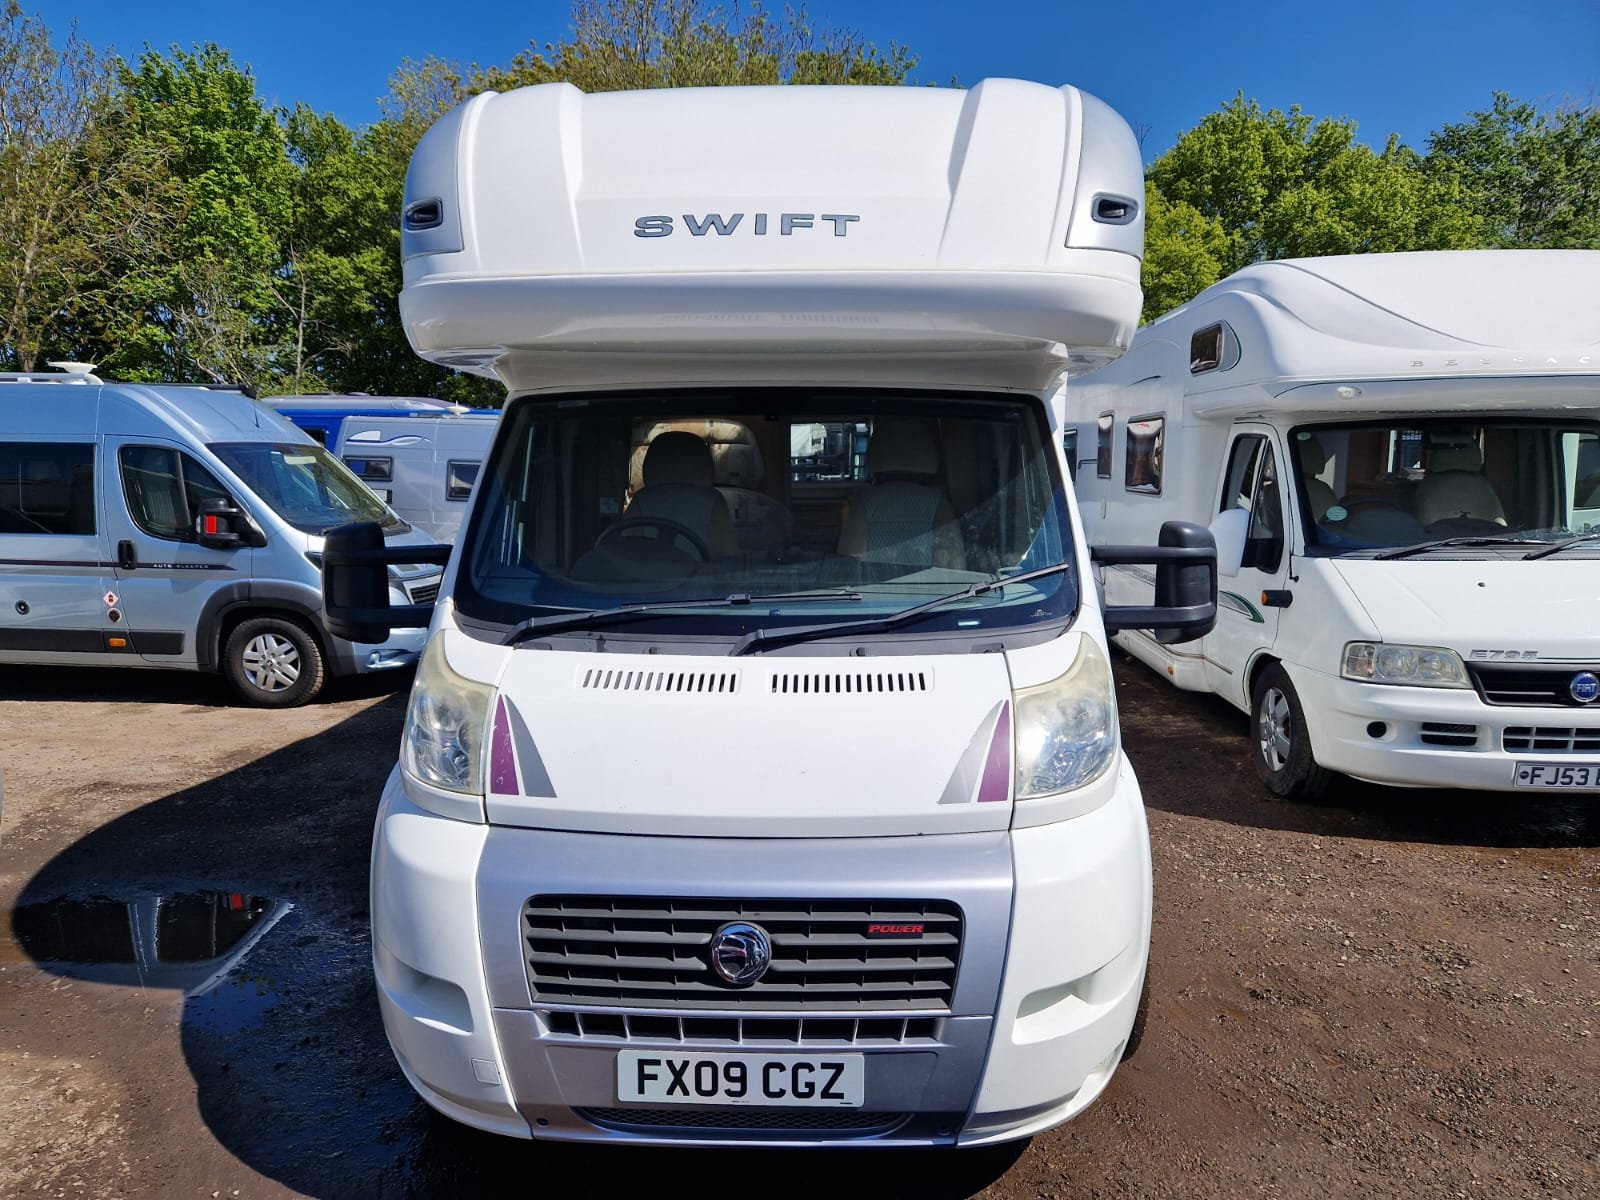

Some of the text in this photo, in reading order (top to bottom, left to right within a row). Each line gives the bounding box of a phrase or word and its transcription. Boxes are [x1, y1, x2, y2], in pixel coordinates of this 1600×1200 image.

[634, 212, 860, 238] SWIFT
[1469, 649, 1538, 660] E795
[1576, 683, 1597, 693] FIAT
[1529, 767, 1590, 786] FJ53
[868, 923, 924, 934] POWER
[637, 1058, 845, 1100] FX09 CGZ
